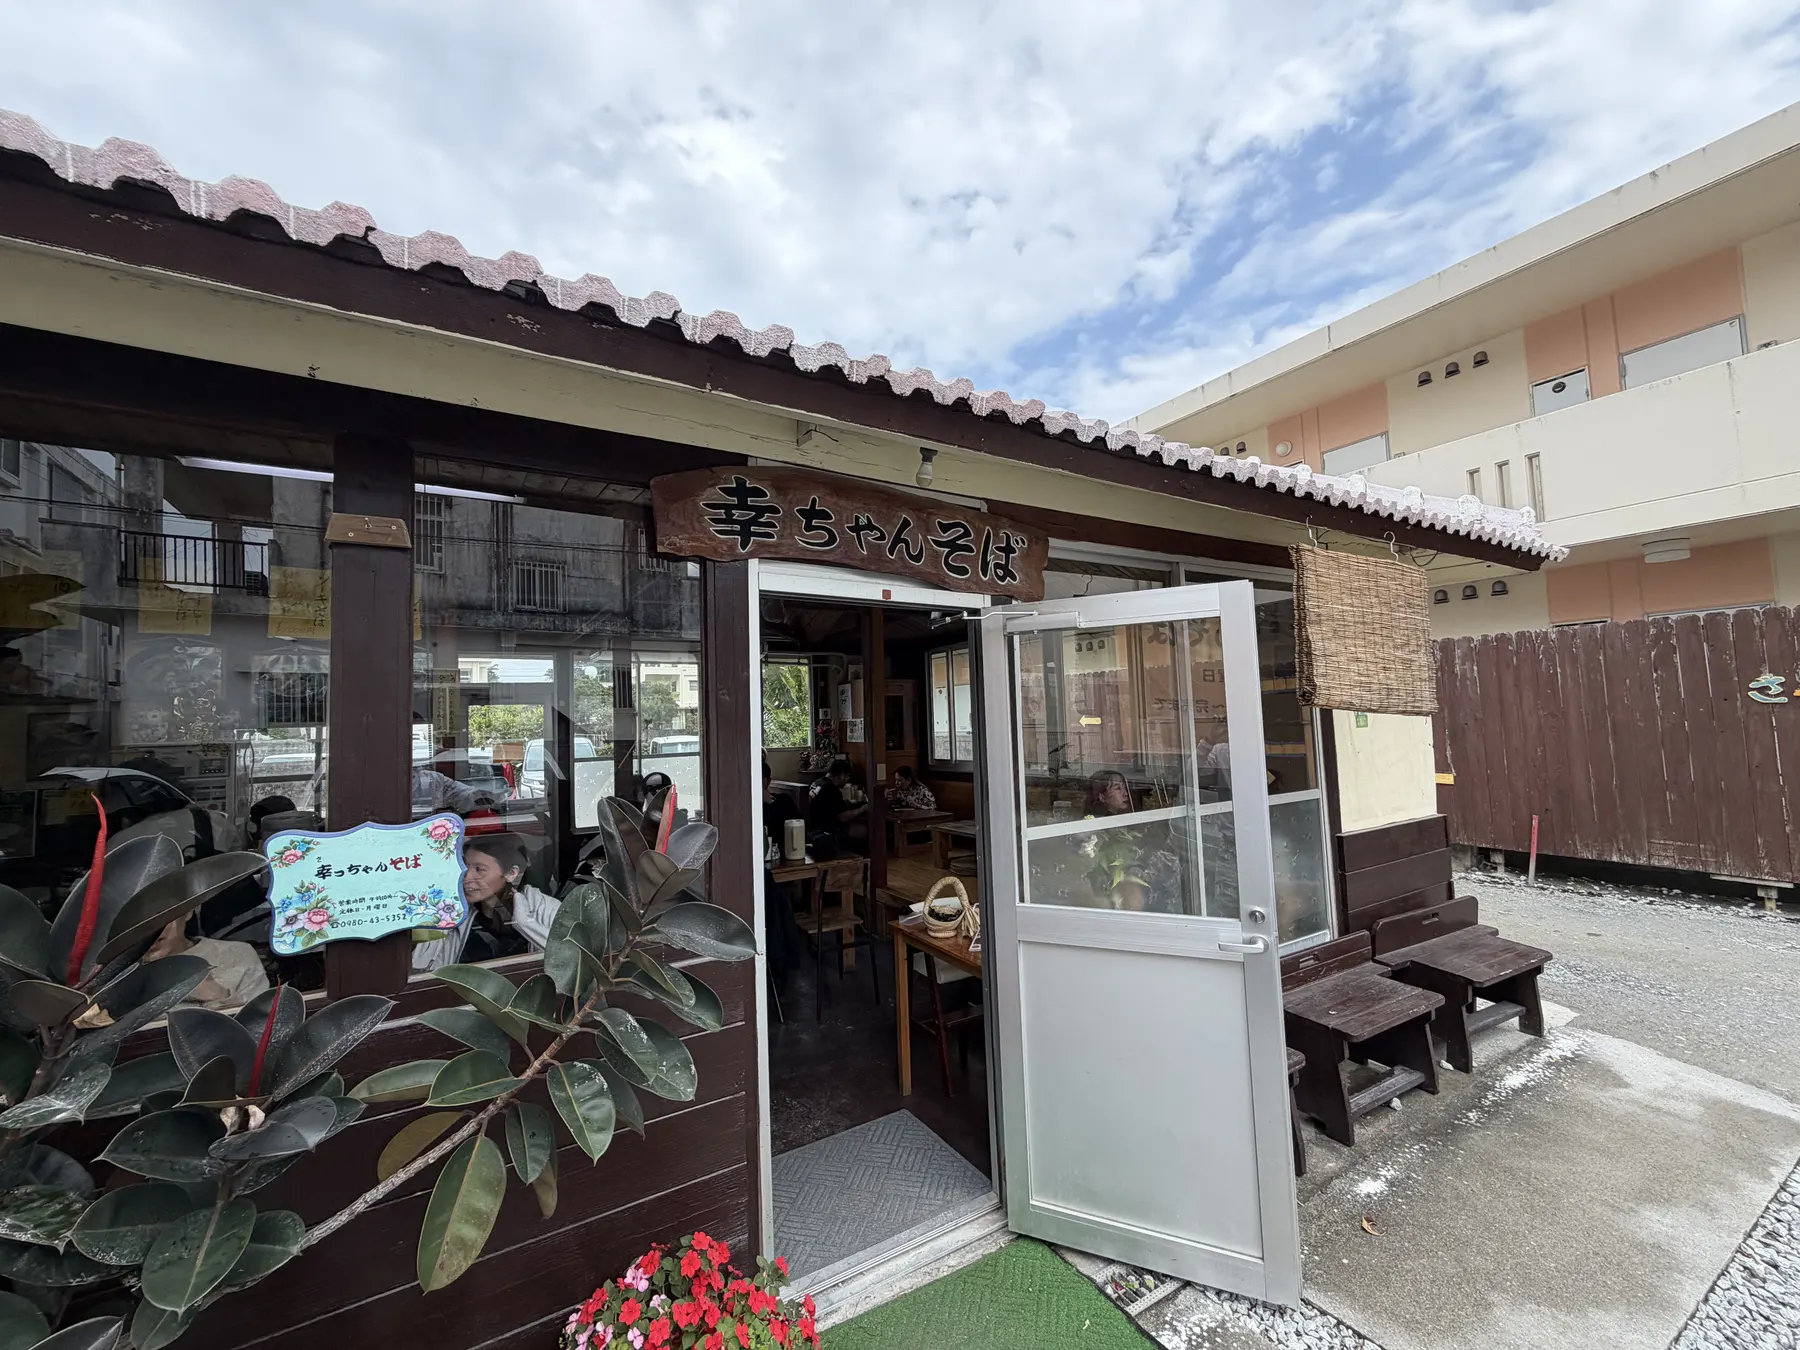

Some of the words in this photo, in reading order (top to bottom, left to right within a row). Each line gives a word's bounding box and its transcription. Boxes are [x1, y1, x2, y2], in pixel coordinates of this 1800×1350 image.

[701, 475, 1026, 584] 幸ちゃんそば
[1747, 675, 1800, 704] さ
[314, 853, 423, 880] 幸っちゃんそば
[340, 913, 407, 928] 0980-43-5352
